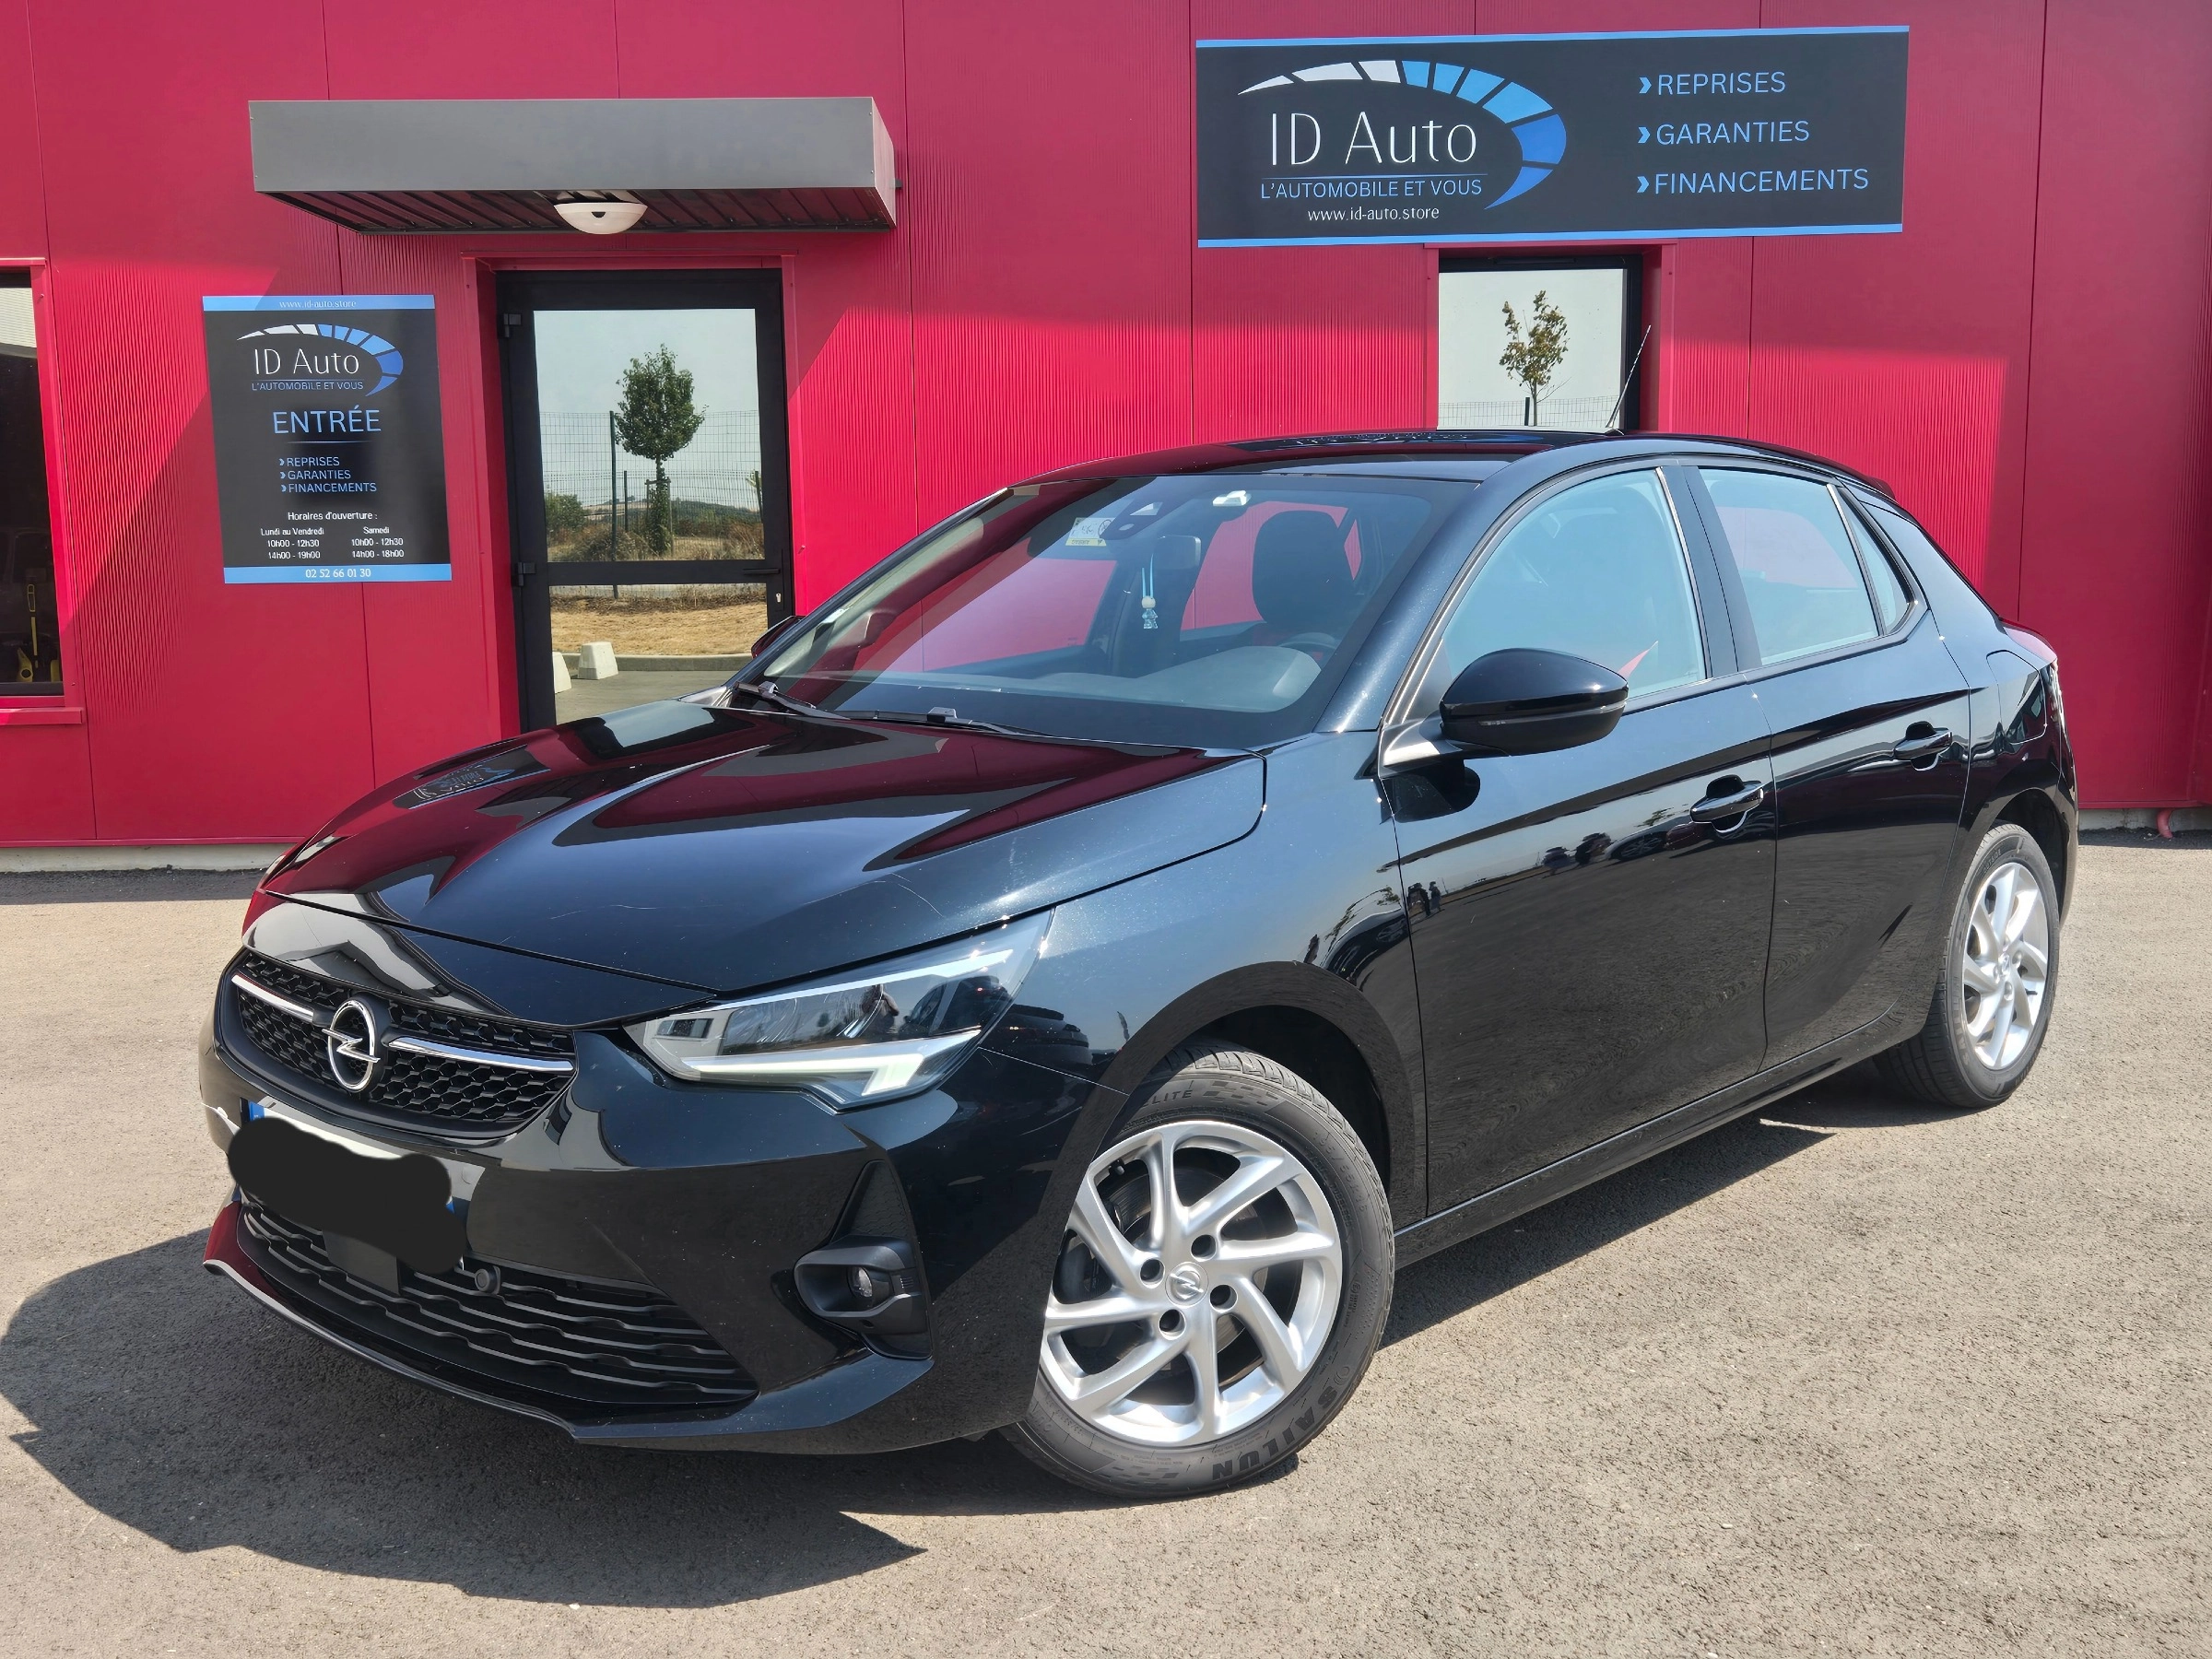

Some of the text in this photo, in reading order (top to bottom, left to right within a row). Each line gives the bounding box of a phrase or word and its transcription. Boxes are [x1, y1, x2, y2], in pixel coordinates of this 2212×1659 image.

[1658, 71, 1786, 95] REPRISES
[1656, 120, 1810, 145] GARANTIES
[1272, 111, 1477, 166] ID Auto
[1654, 168, 1869, 194] FINANCEMENTS
[1261, 179, 1482, 199] L'AUTOMOBILE ET VOUS
[1308, 206, 1440, 222] www.id-auto.store
[279, 300, 357, 308] www.id-auto.store
[254, 347, 359, 375] ID Auto
[252, 382, 364, 391] L'AUTOMOBILE ET VOUS
[273, 404, 382, 434] ENTRÉE
[287, 456, 340, 467] REPRISES
[288, 469, 351, 480] GARANTIES
[288, 482, 377, 493] FINANCEMENTS
[288, 512, 324, 521] Horaires
[325, 512, 372, 521] d'ouverture
[260, 527, 280, 536] Lundi
[292, 527, 324, 535] Vendredi
[363, 526, 390, 535] Samedi
[267, 539, 290, 547] 10h00
[297, 539, 320, 547] 12h30
[351, 537, 374, 547] 10h00
[381, 537, 404, 546] 12h30
[268, 551, 291, 559] 14h00
[298, 551, 321, 559] 19h00
[352, 550, 375, 559] 14h00
[382, 549, 405, 558] 18h00
[305, 568, 371, 578] 02 52 66 01 30
[1143, 1089, 1194, 1108] LITE
[1212, 1385, 1337, 1481] SAILUN
